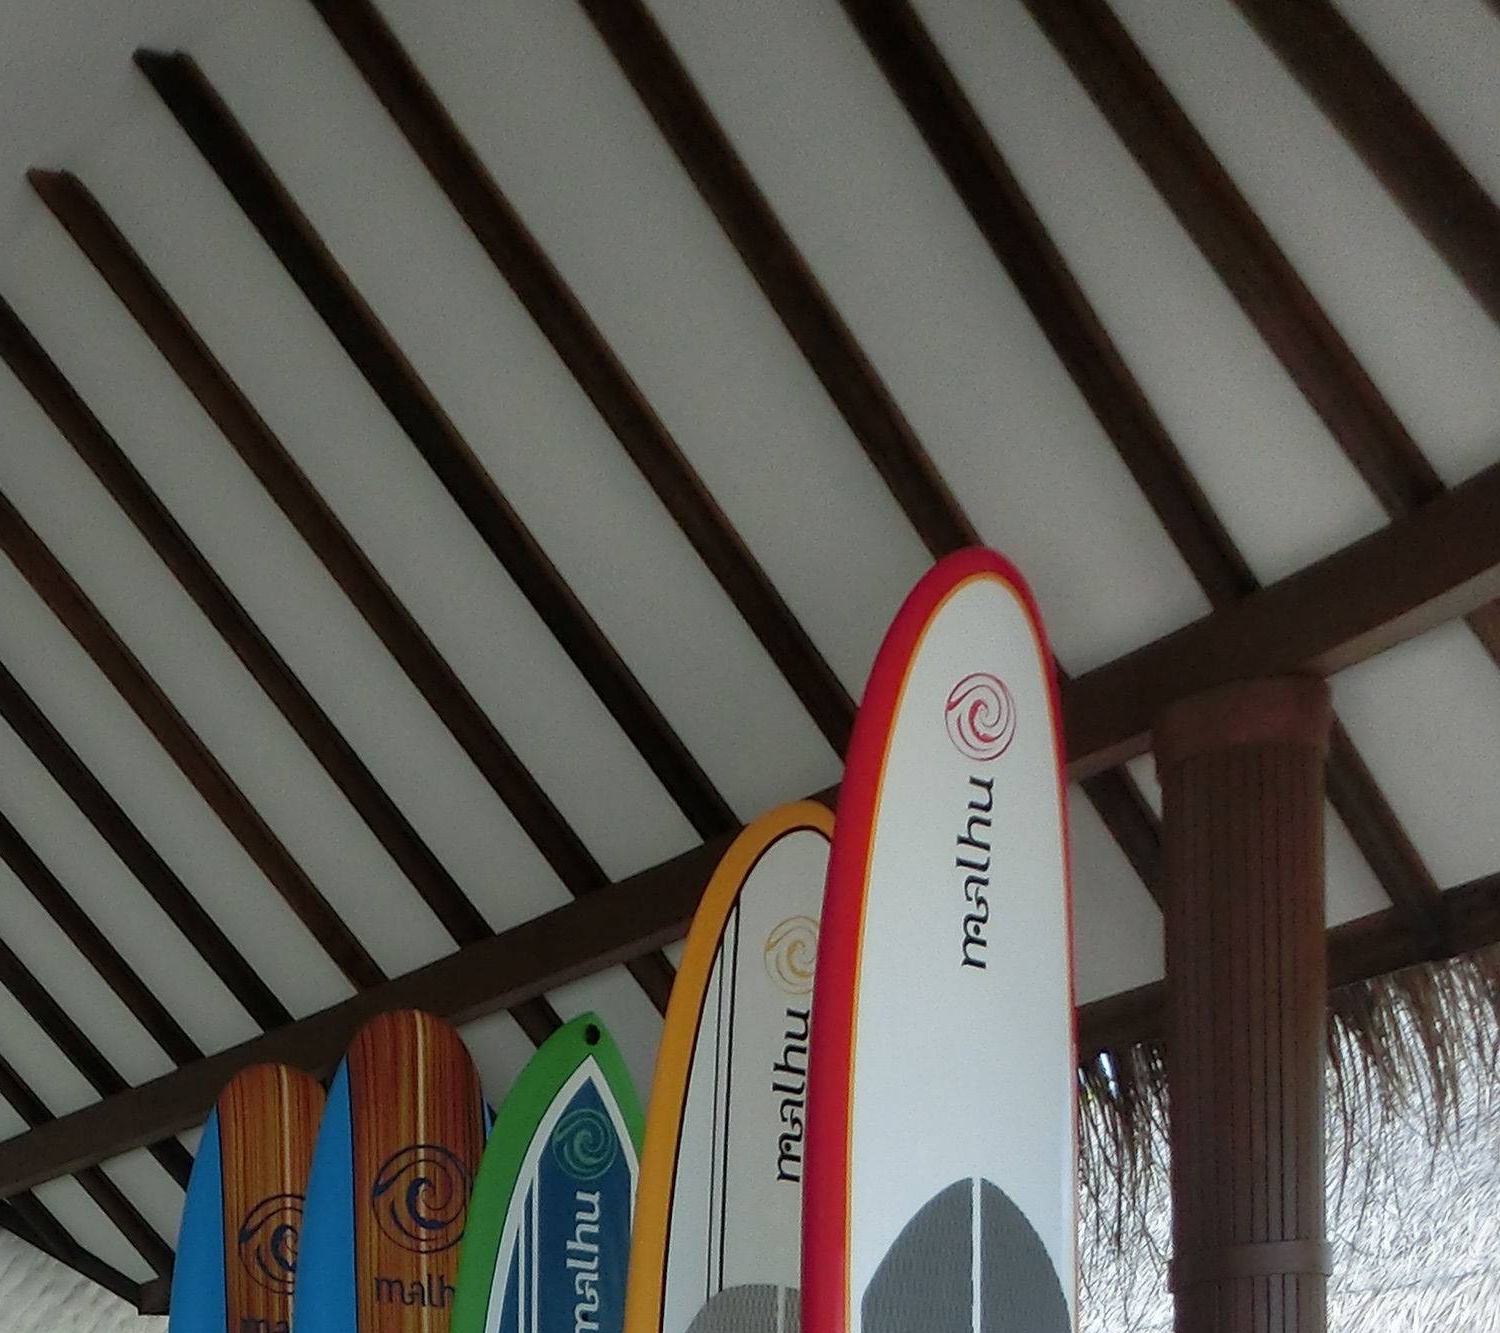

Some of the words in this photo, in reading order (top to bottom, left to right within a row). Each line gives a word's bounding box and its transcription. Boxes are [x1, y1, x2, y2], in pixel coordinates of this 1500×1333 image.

[955, 775, 994, 969] malhu
[772, 1008, 810, 1182] malhu
[375, 1272, 456, 1309] malh
